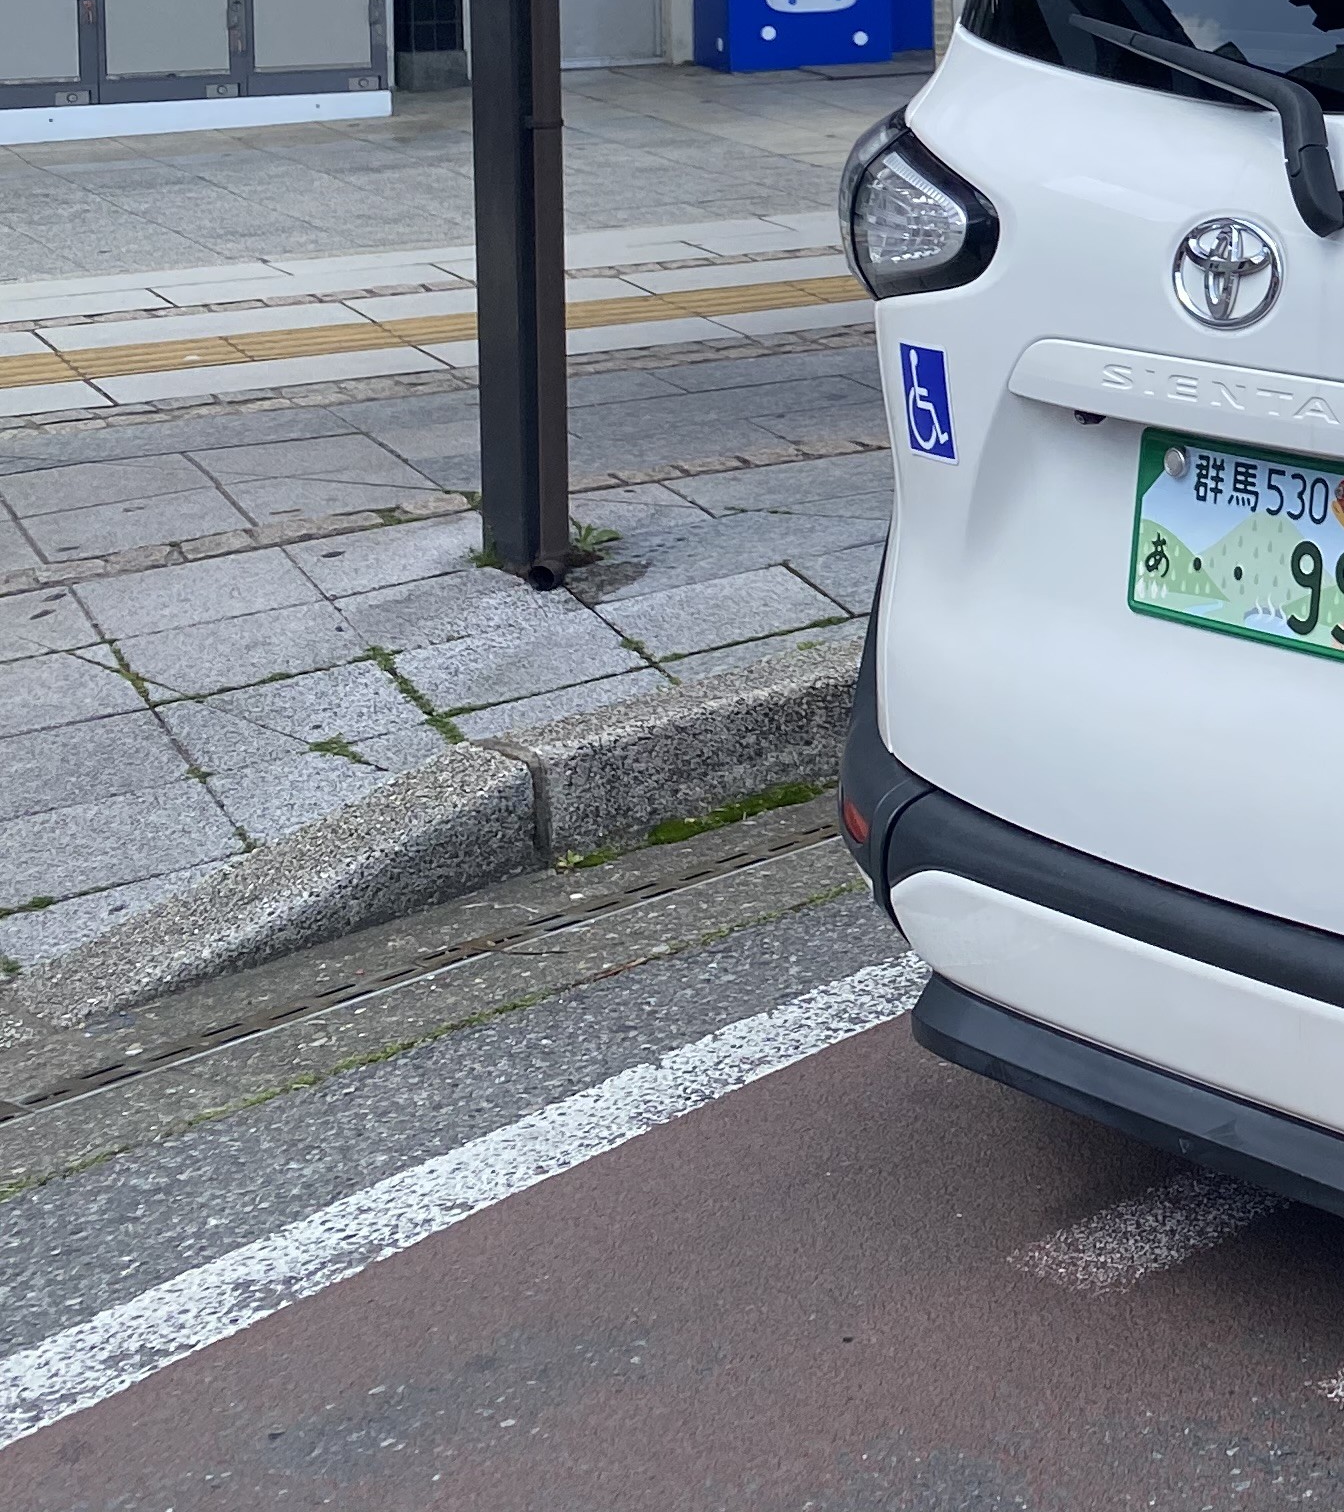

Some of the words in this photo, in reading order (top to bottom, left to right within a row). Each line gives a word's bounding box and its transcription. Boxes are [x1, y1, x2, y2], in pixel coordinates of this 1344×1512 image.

[1101, 364, 1340, 425] SIENTA
[1193, 454, 1330, 525] 群馬530
[1144, 532, 1170, 578] あ
